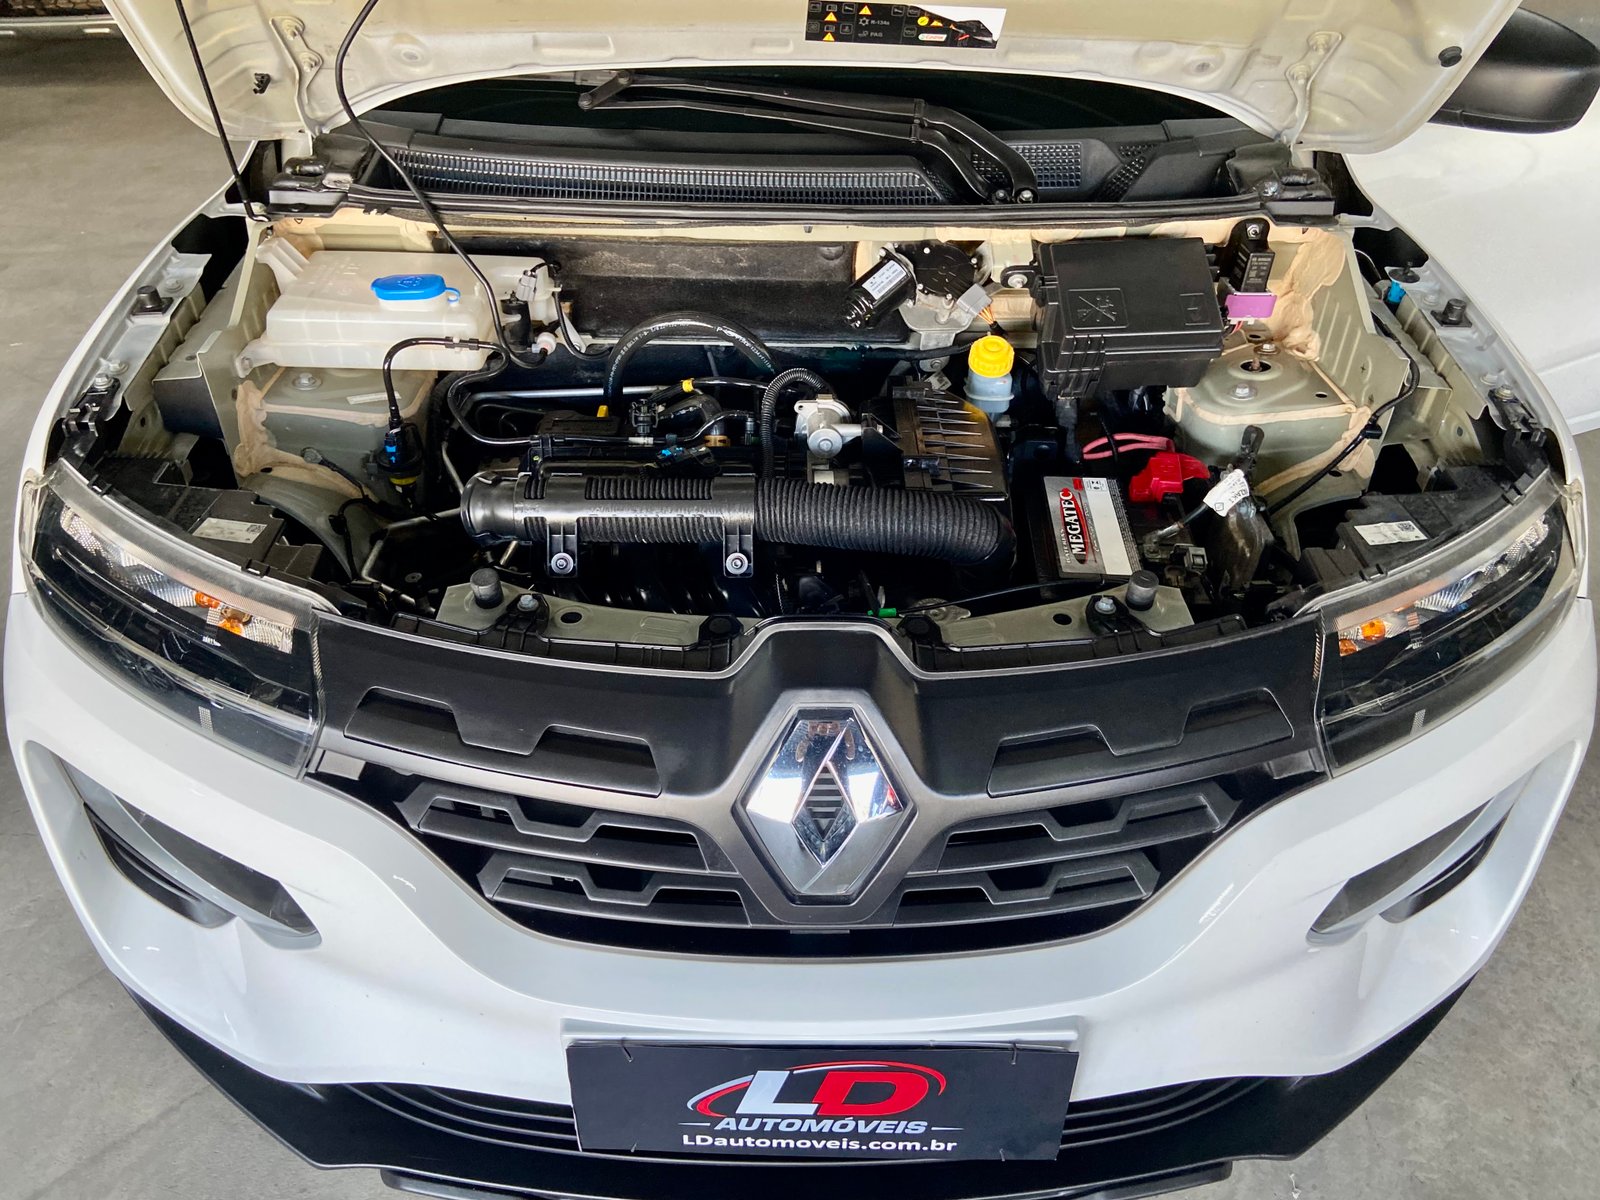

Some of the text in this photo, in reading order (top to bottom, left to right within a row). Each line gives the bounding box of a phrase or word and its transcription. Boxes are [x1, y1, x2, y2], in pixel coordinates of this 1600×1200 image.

[1060, 490, 1087, 555] MEGATEC
[735, 1070, 930, 1116] LD
[714, 1116, 928, 1135] AUTOMÓVEIS
[682, 1134, 958, 1151] LDautomoveis.com.br
